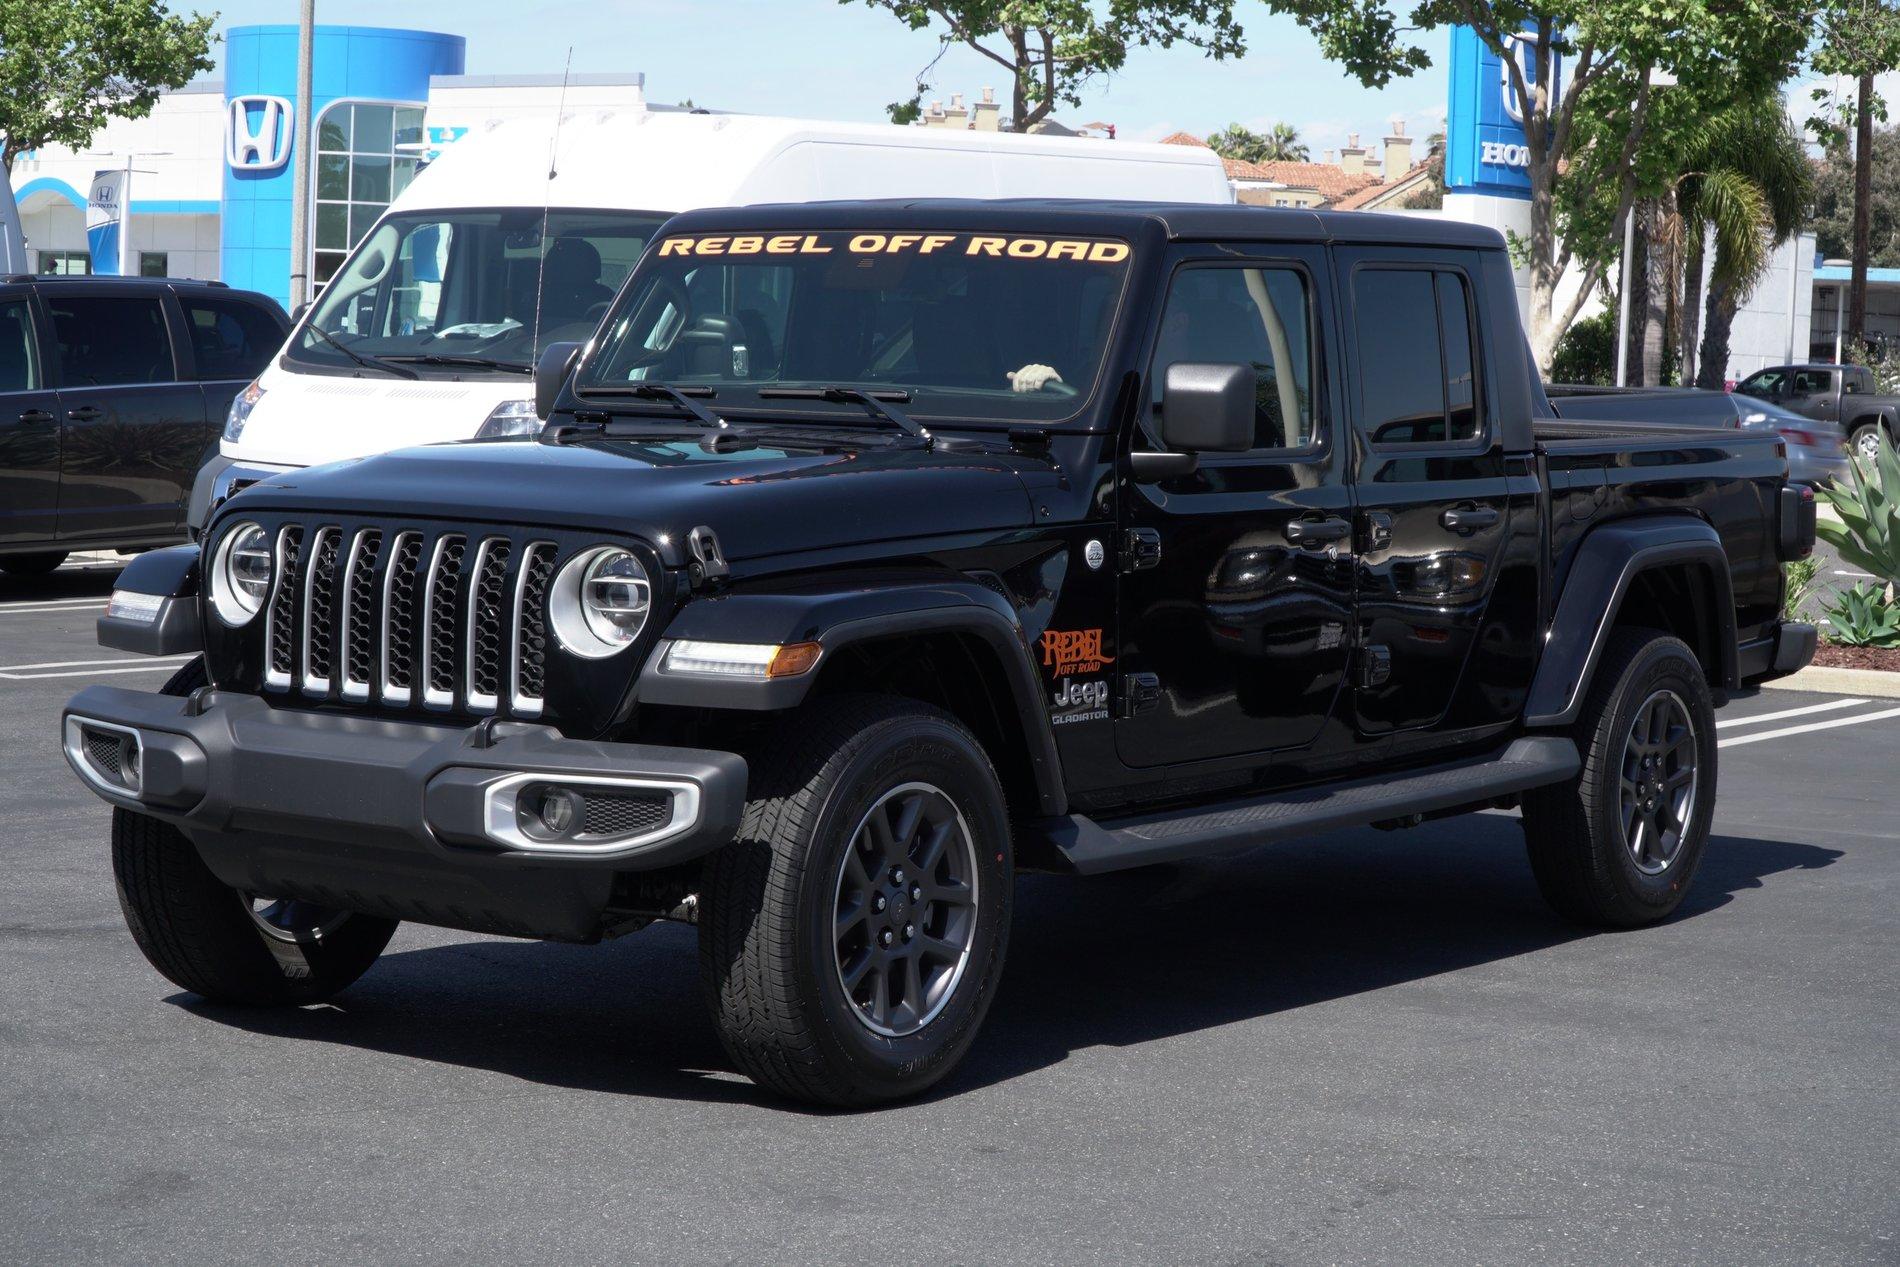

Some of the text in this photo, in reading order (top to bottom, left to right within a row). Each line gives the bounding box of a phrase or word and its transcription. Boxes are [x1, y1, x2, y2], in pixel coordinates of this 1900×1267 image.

[658, 234, 1130, 263] REBEL OFF ROAD
[1040, 629, 1115, 680] REBEL
[1060, 661, 1101, 675] OFF ROAD
[1054, 678, 1108, 708] Jeep
[1052, 710, 1109, 725] GLADIATOR
